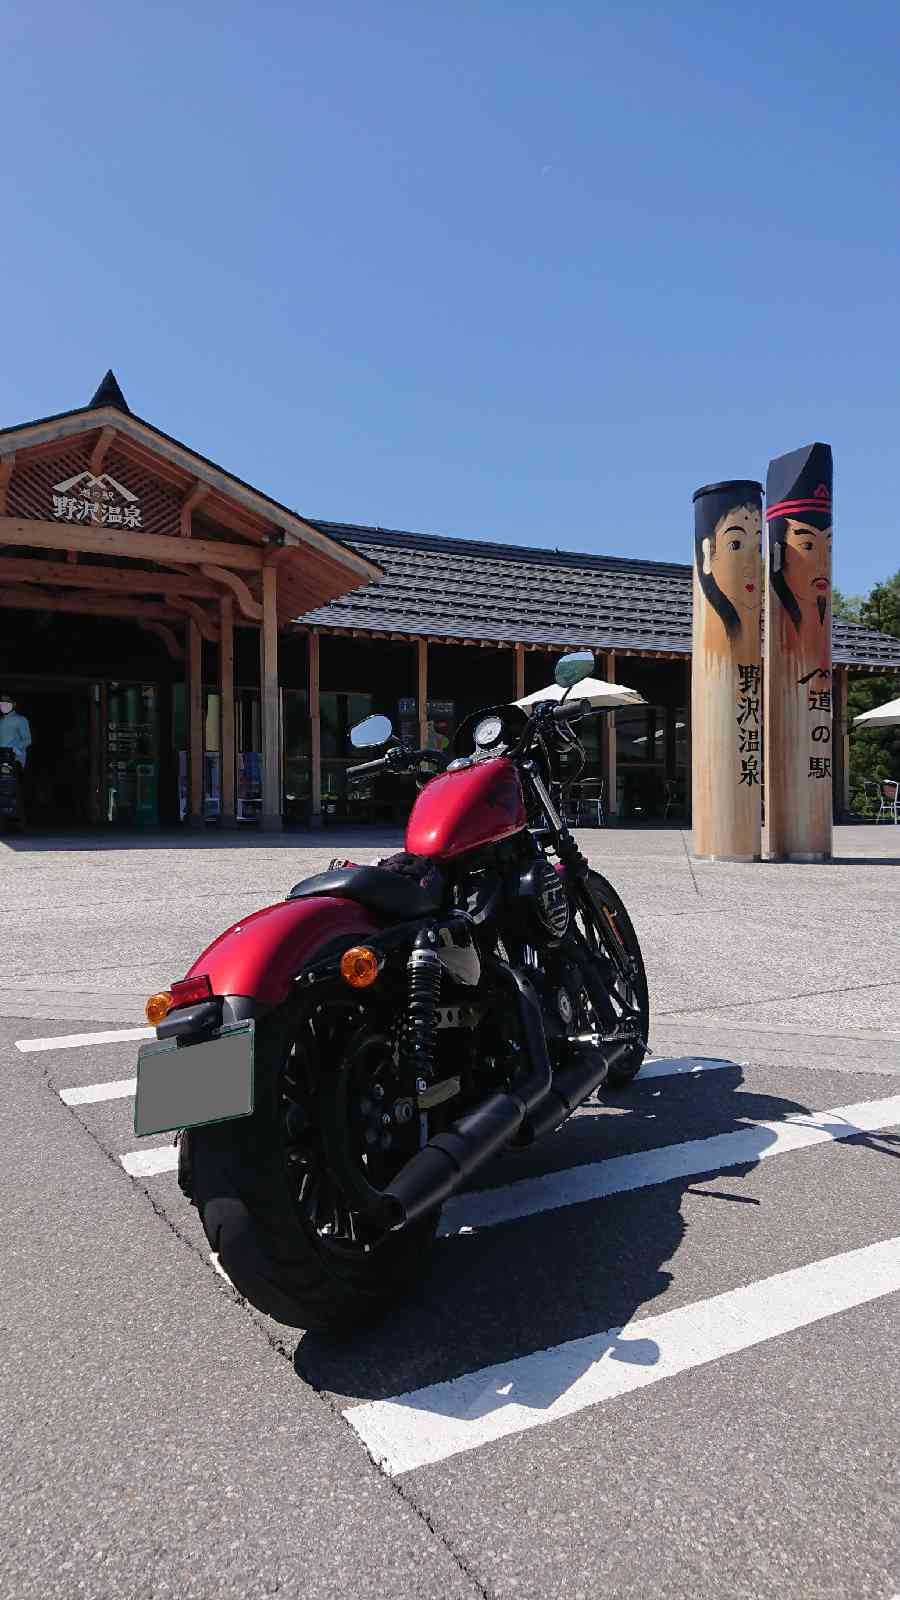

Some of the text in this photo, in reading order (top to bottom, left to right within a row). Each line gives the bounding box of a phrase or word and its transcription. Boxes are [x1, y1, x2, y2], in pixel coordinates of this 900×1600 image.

[52, 494, 144, 528] 野沢温泉
[737, 663, 761, 787] 野沢温泉
[808, 689, 831, 779] 道の駅
